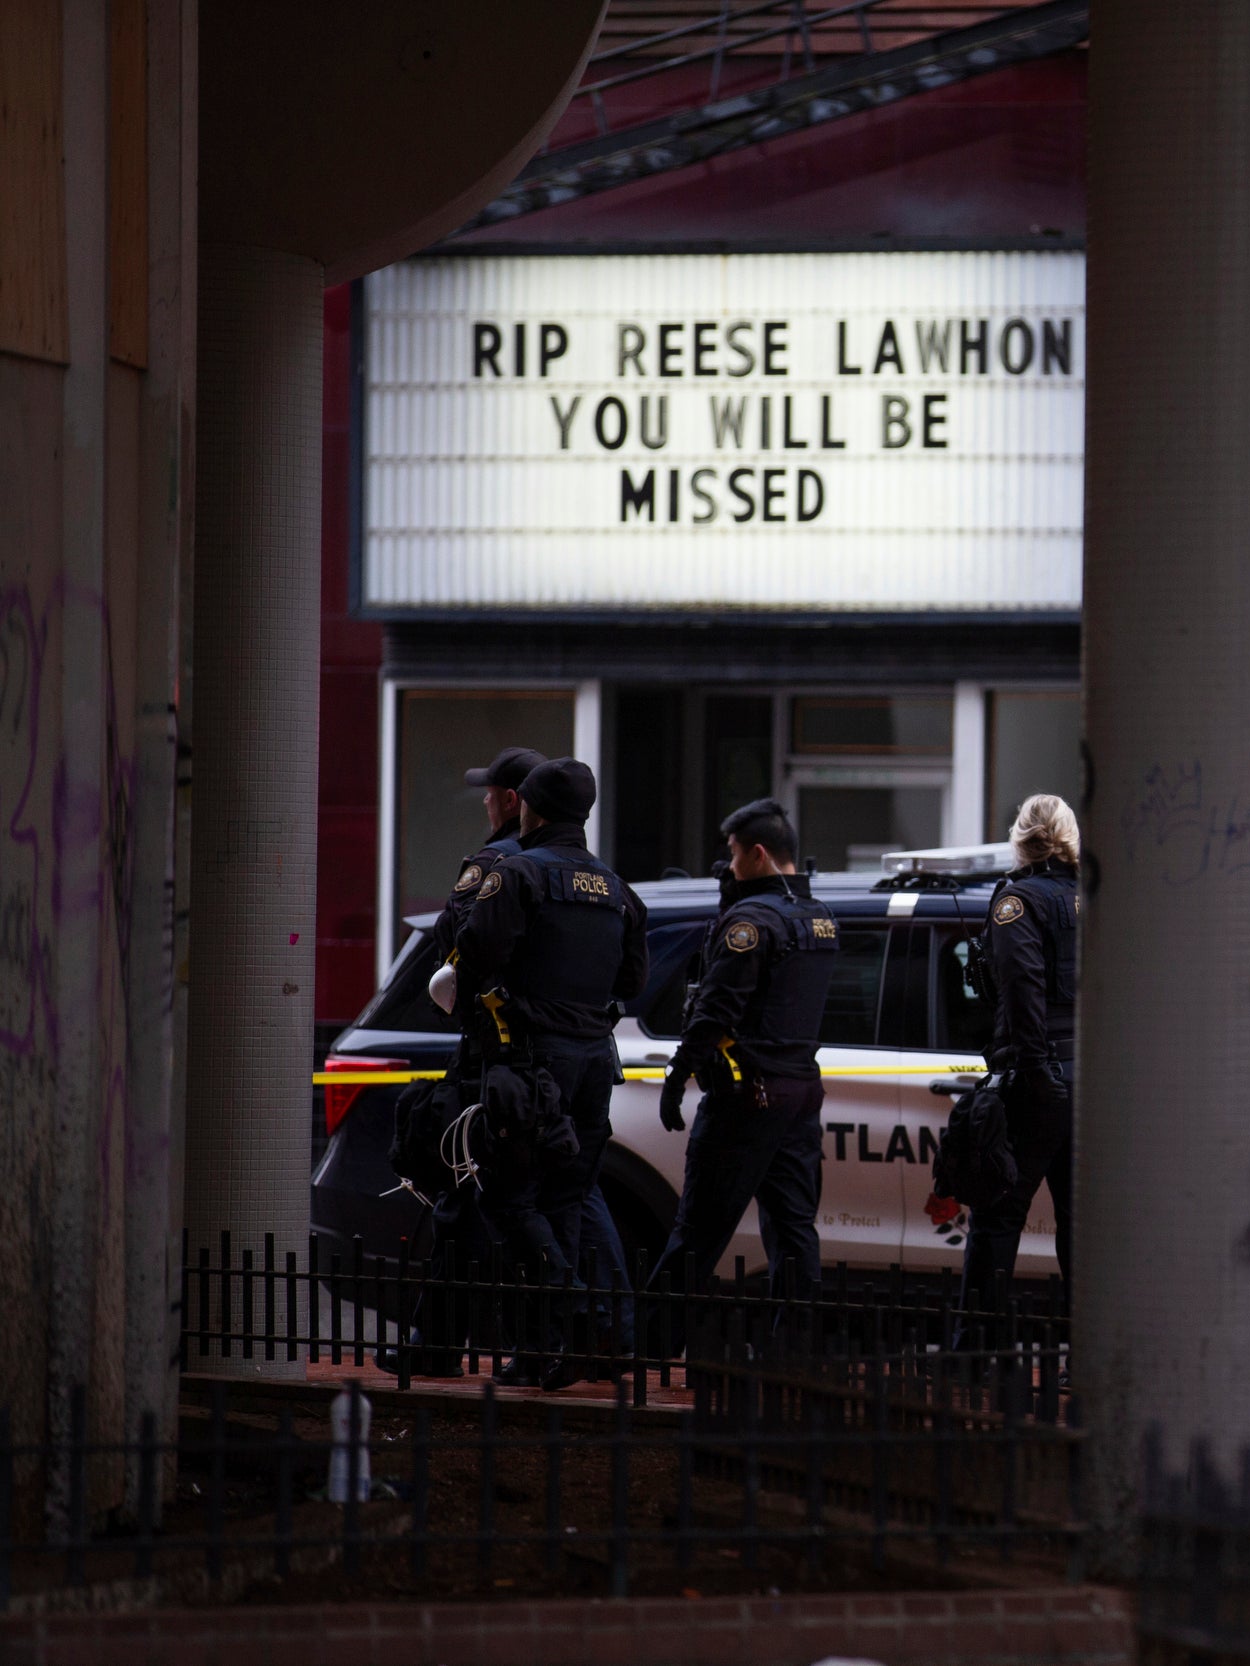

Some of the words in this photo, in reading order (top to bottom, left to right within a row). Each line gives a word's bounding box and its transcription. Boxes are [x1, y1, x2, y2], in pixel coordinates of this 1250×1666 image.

[473, 322, 569, 378] RIP
[617, 321, 790, 378] REESE
[838, 318, 1073, 376] LAWHON
[551, 395, 669, 451] YOU
[711, 394, 846, 450] WILL
[882, 393, 950, 450] BE
[619, 468, 826, 524] MISSED
[573, 878, 609, 895] POLICE
[820, 1122, 948, 1164] TLAN
